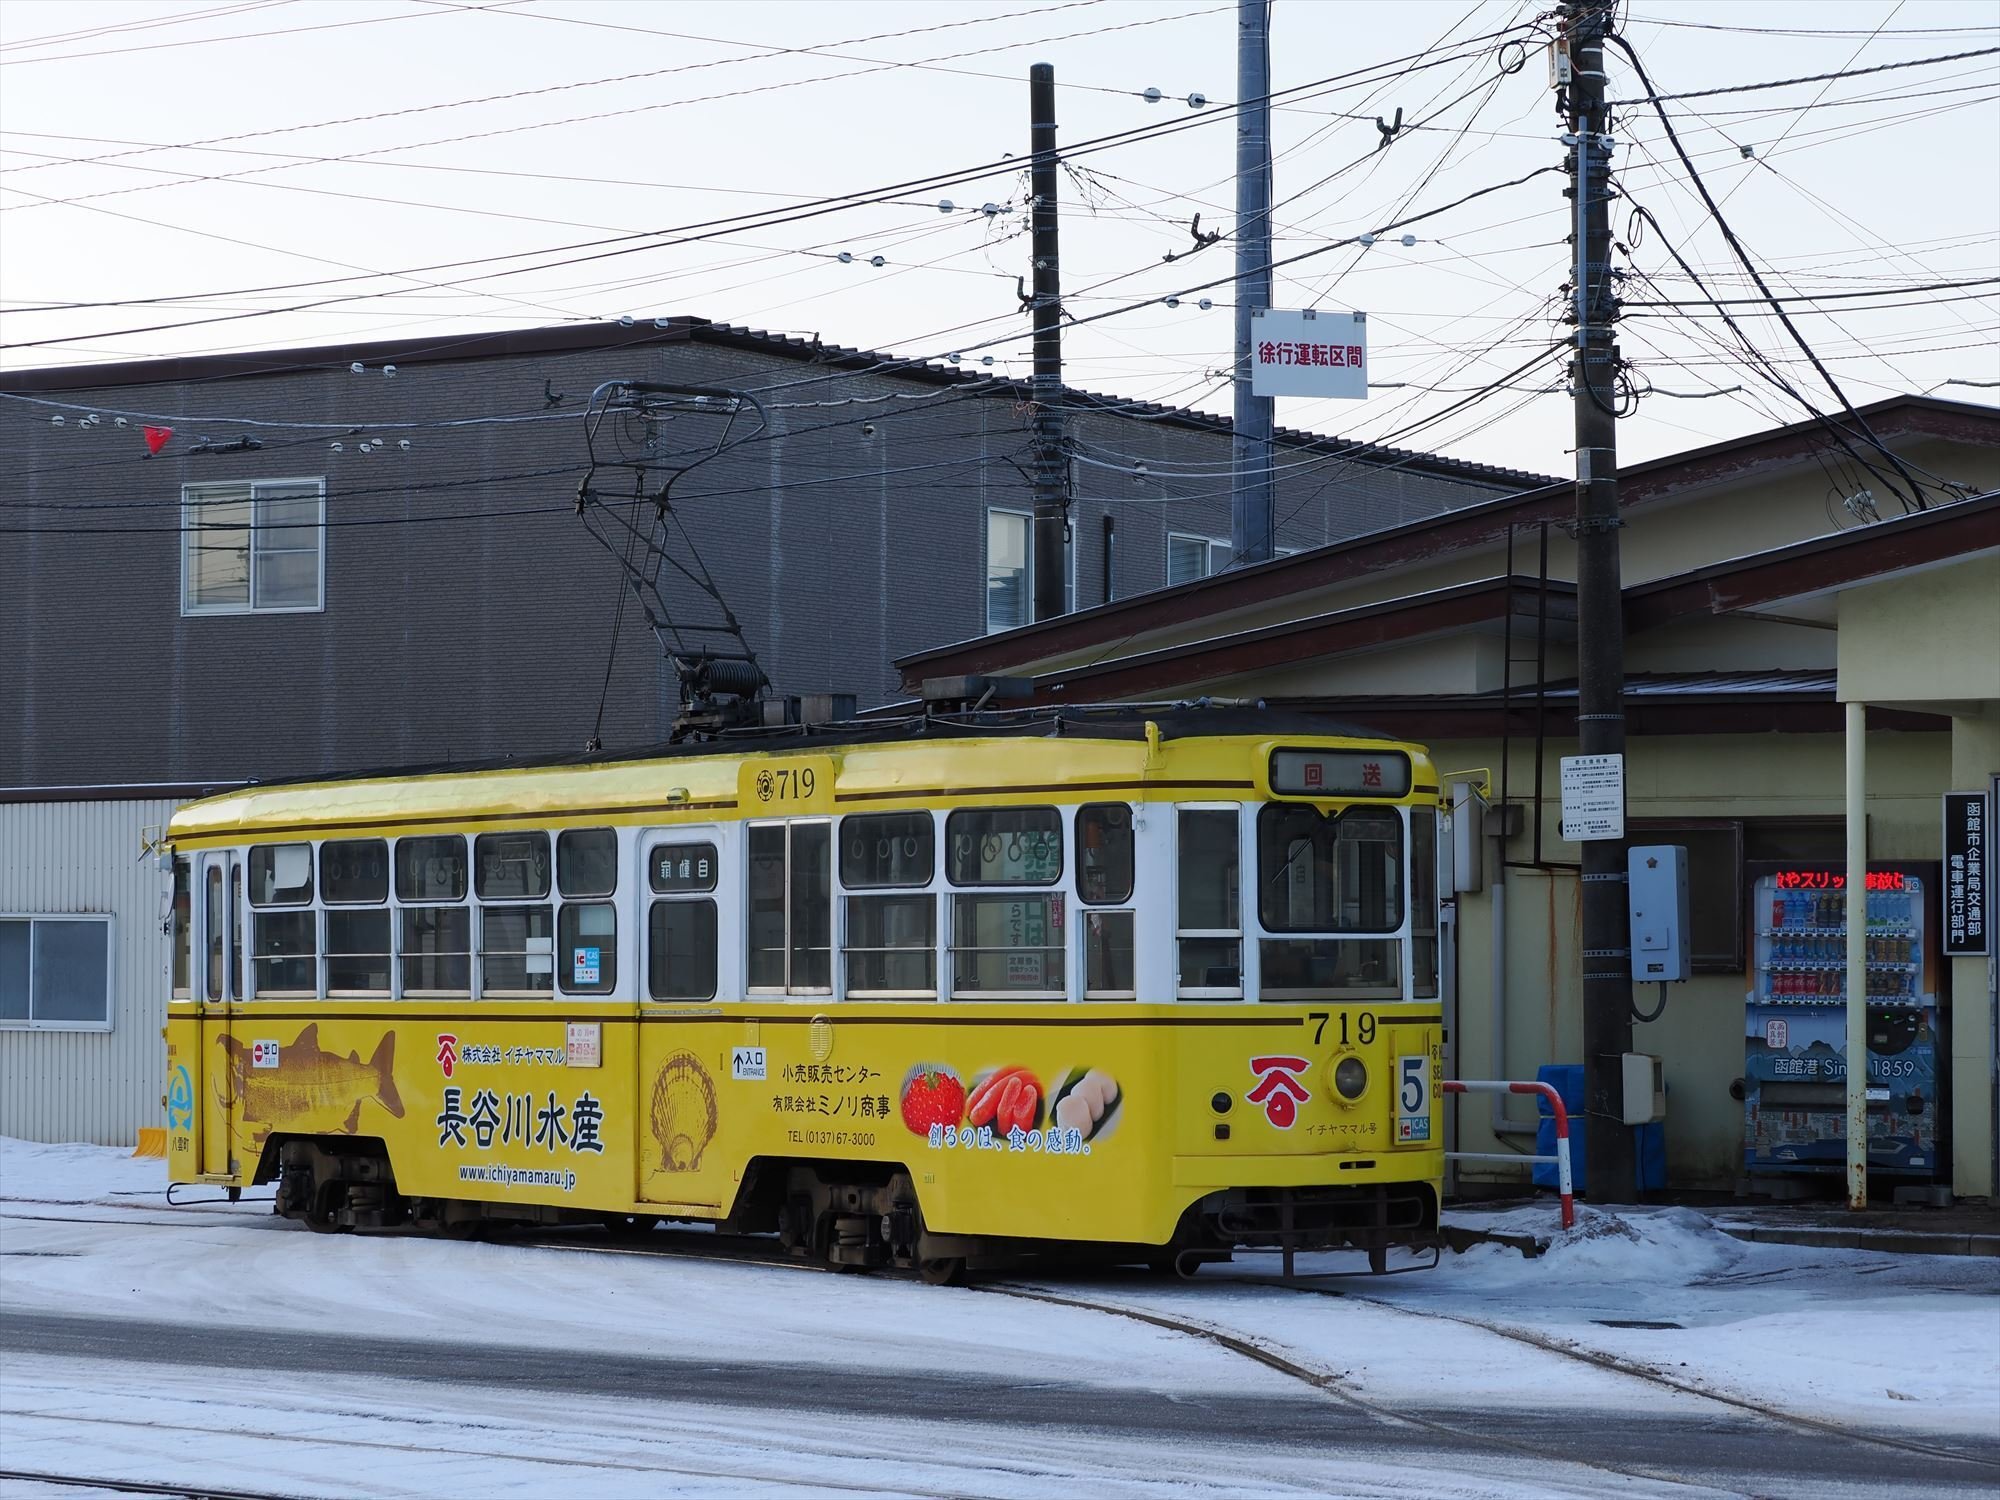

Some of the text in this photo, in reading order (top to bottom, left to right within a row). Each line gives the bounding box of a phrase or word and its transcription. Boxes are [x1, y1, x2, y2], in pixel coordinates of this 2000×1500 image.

[1258, 341, 1363, 369] 徐行運転区間
[776, 768, 815, 800] 719
[1305, 763, 1382, 787] 回送
[1776, 872, 1904, 889] やスリッ事故に
[1967, 802, 1981, 936] 函館市企業局交通部
[1951, 854, 1965, 944] 電車運行部門
[1308, 1012, 1376, 1045] 719
[263, 1043, 278, 1055] 出口
[461, 1045, 501, 1063] 株式会社
[505, 1047, 566, 1065] イチヤママル
[745, 1051, 763, 1065] 入口
[782, 1063, 881, 1084] 小売販売センター
[1774, 1058, 1914, 1077] 函館港 Sin 1859
[1402, 1059, 1424, 1113] 5
[773, 1094, 891, 1120] 有限会社ミノリ商事
[437, 1088, 604, 1153] 長谷川水産
[1306, 1123, 1378, 1136] イチヤママル号
[172, 1136, 189, 1153] 八雲町
[788, 1130, 876, 1147] TEL (0137)67-3000
[929, 1124, 1091, 1153] 創るのは、食の感動。
[460, 1164, 576, 1190] www.ichiyamamaru.jp
